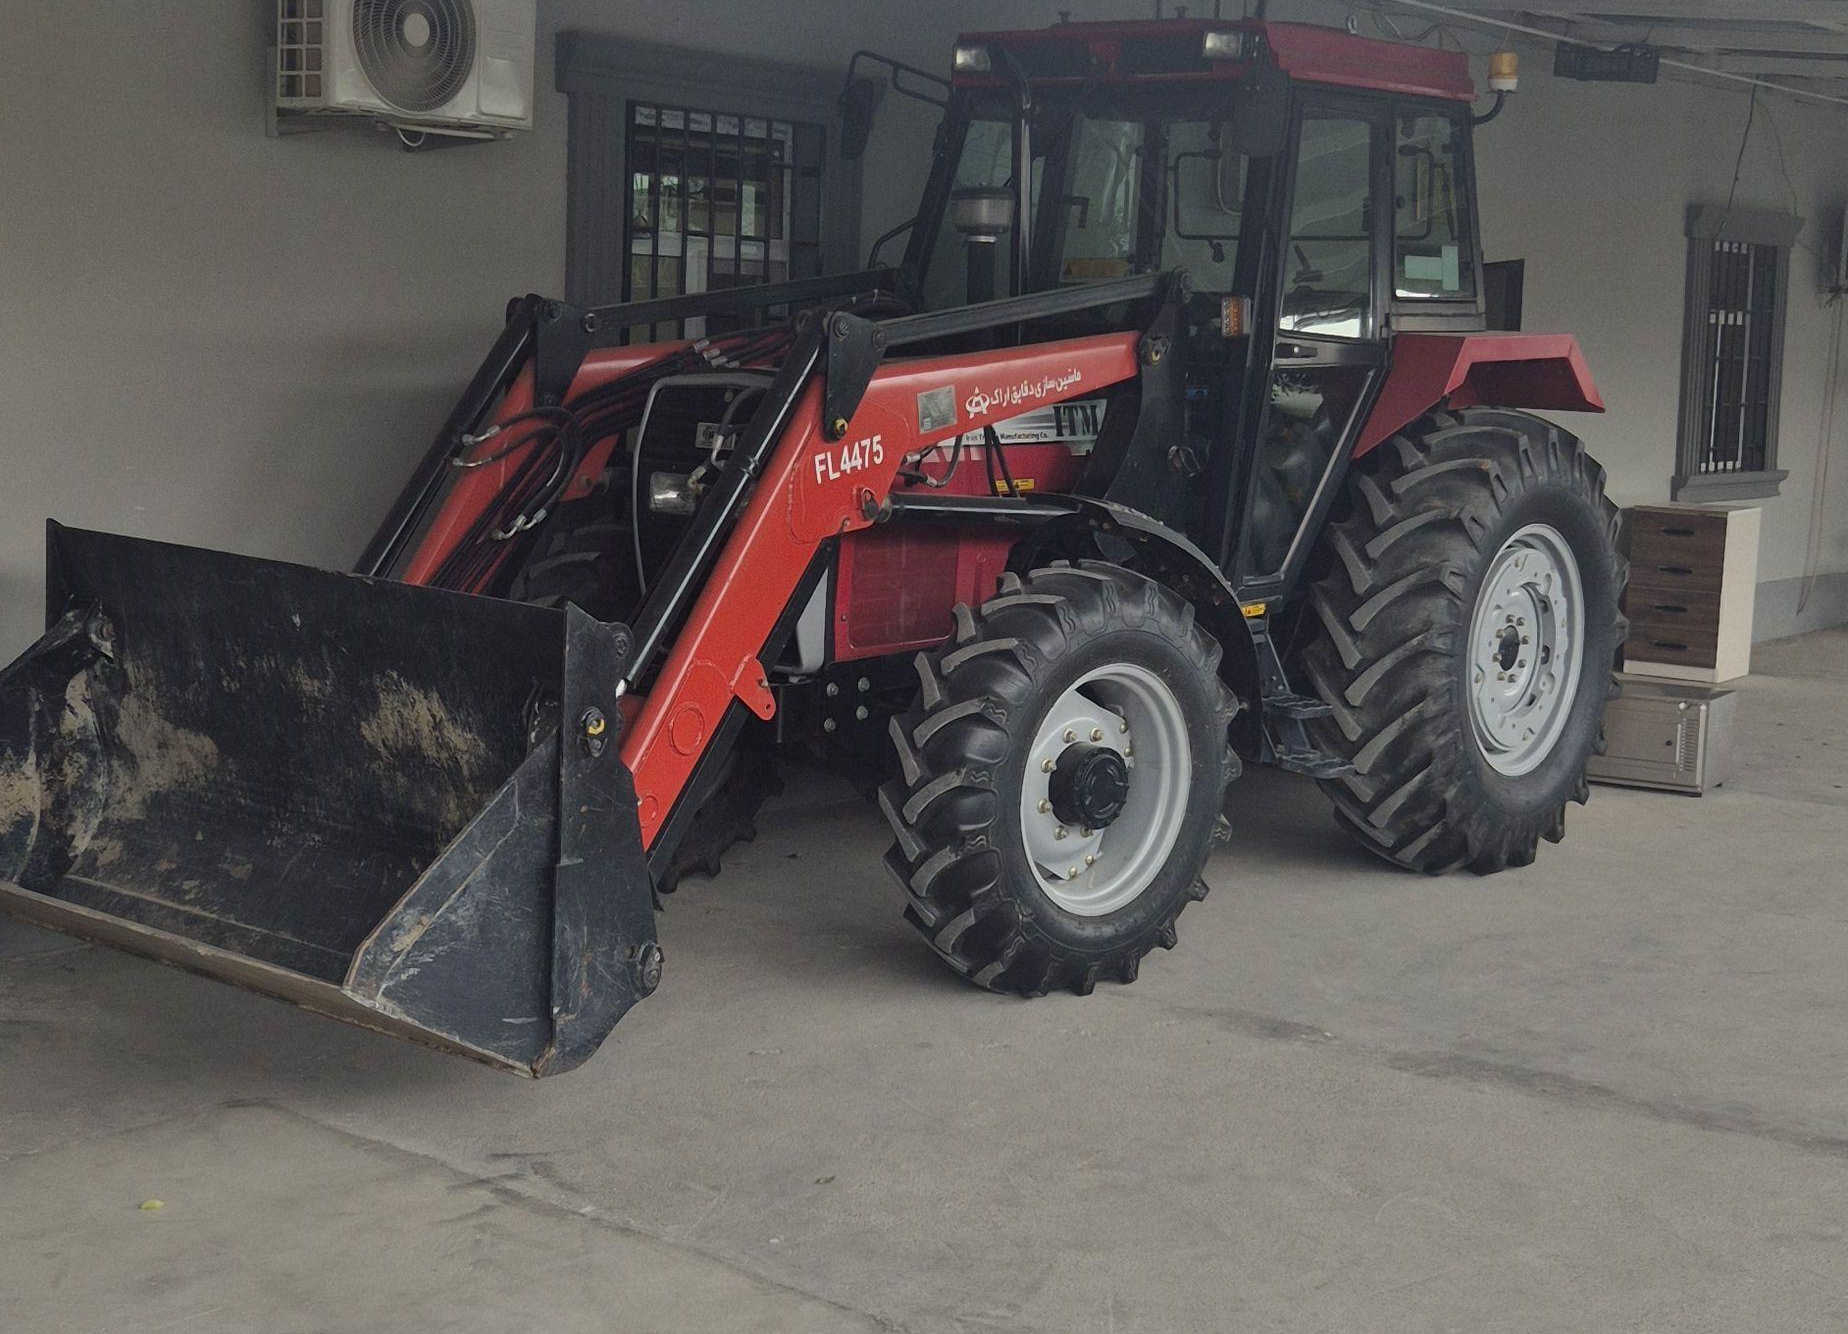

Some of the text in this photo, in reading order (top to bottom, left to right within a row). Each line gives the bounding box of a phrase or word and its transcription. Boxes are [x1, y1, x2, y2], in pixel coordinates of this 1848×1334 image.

[1056, 368, 1081, 392] ماشین
[1052, 405, 1100, 437] ITM
[814, 434, 884, 485] FL4475
